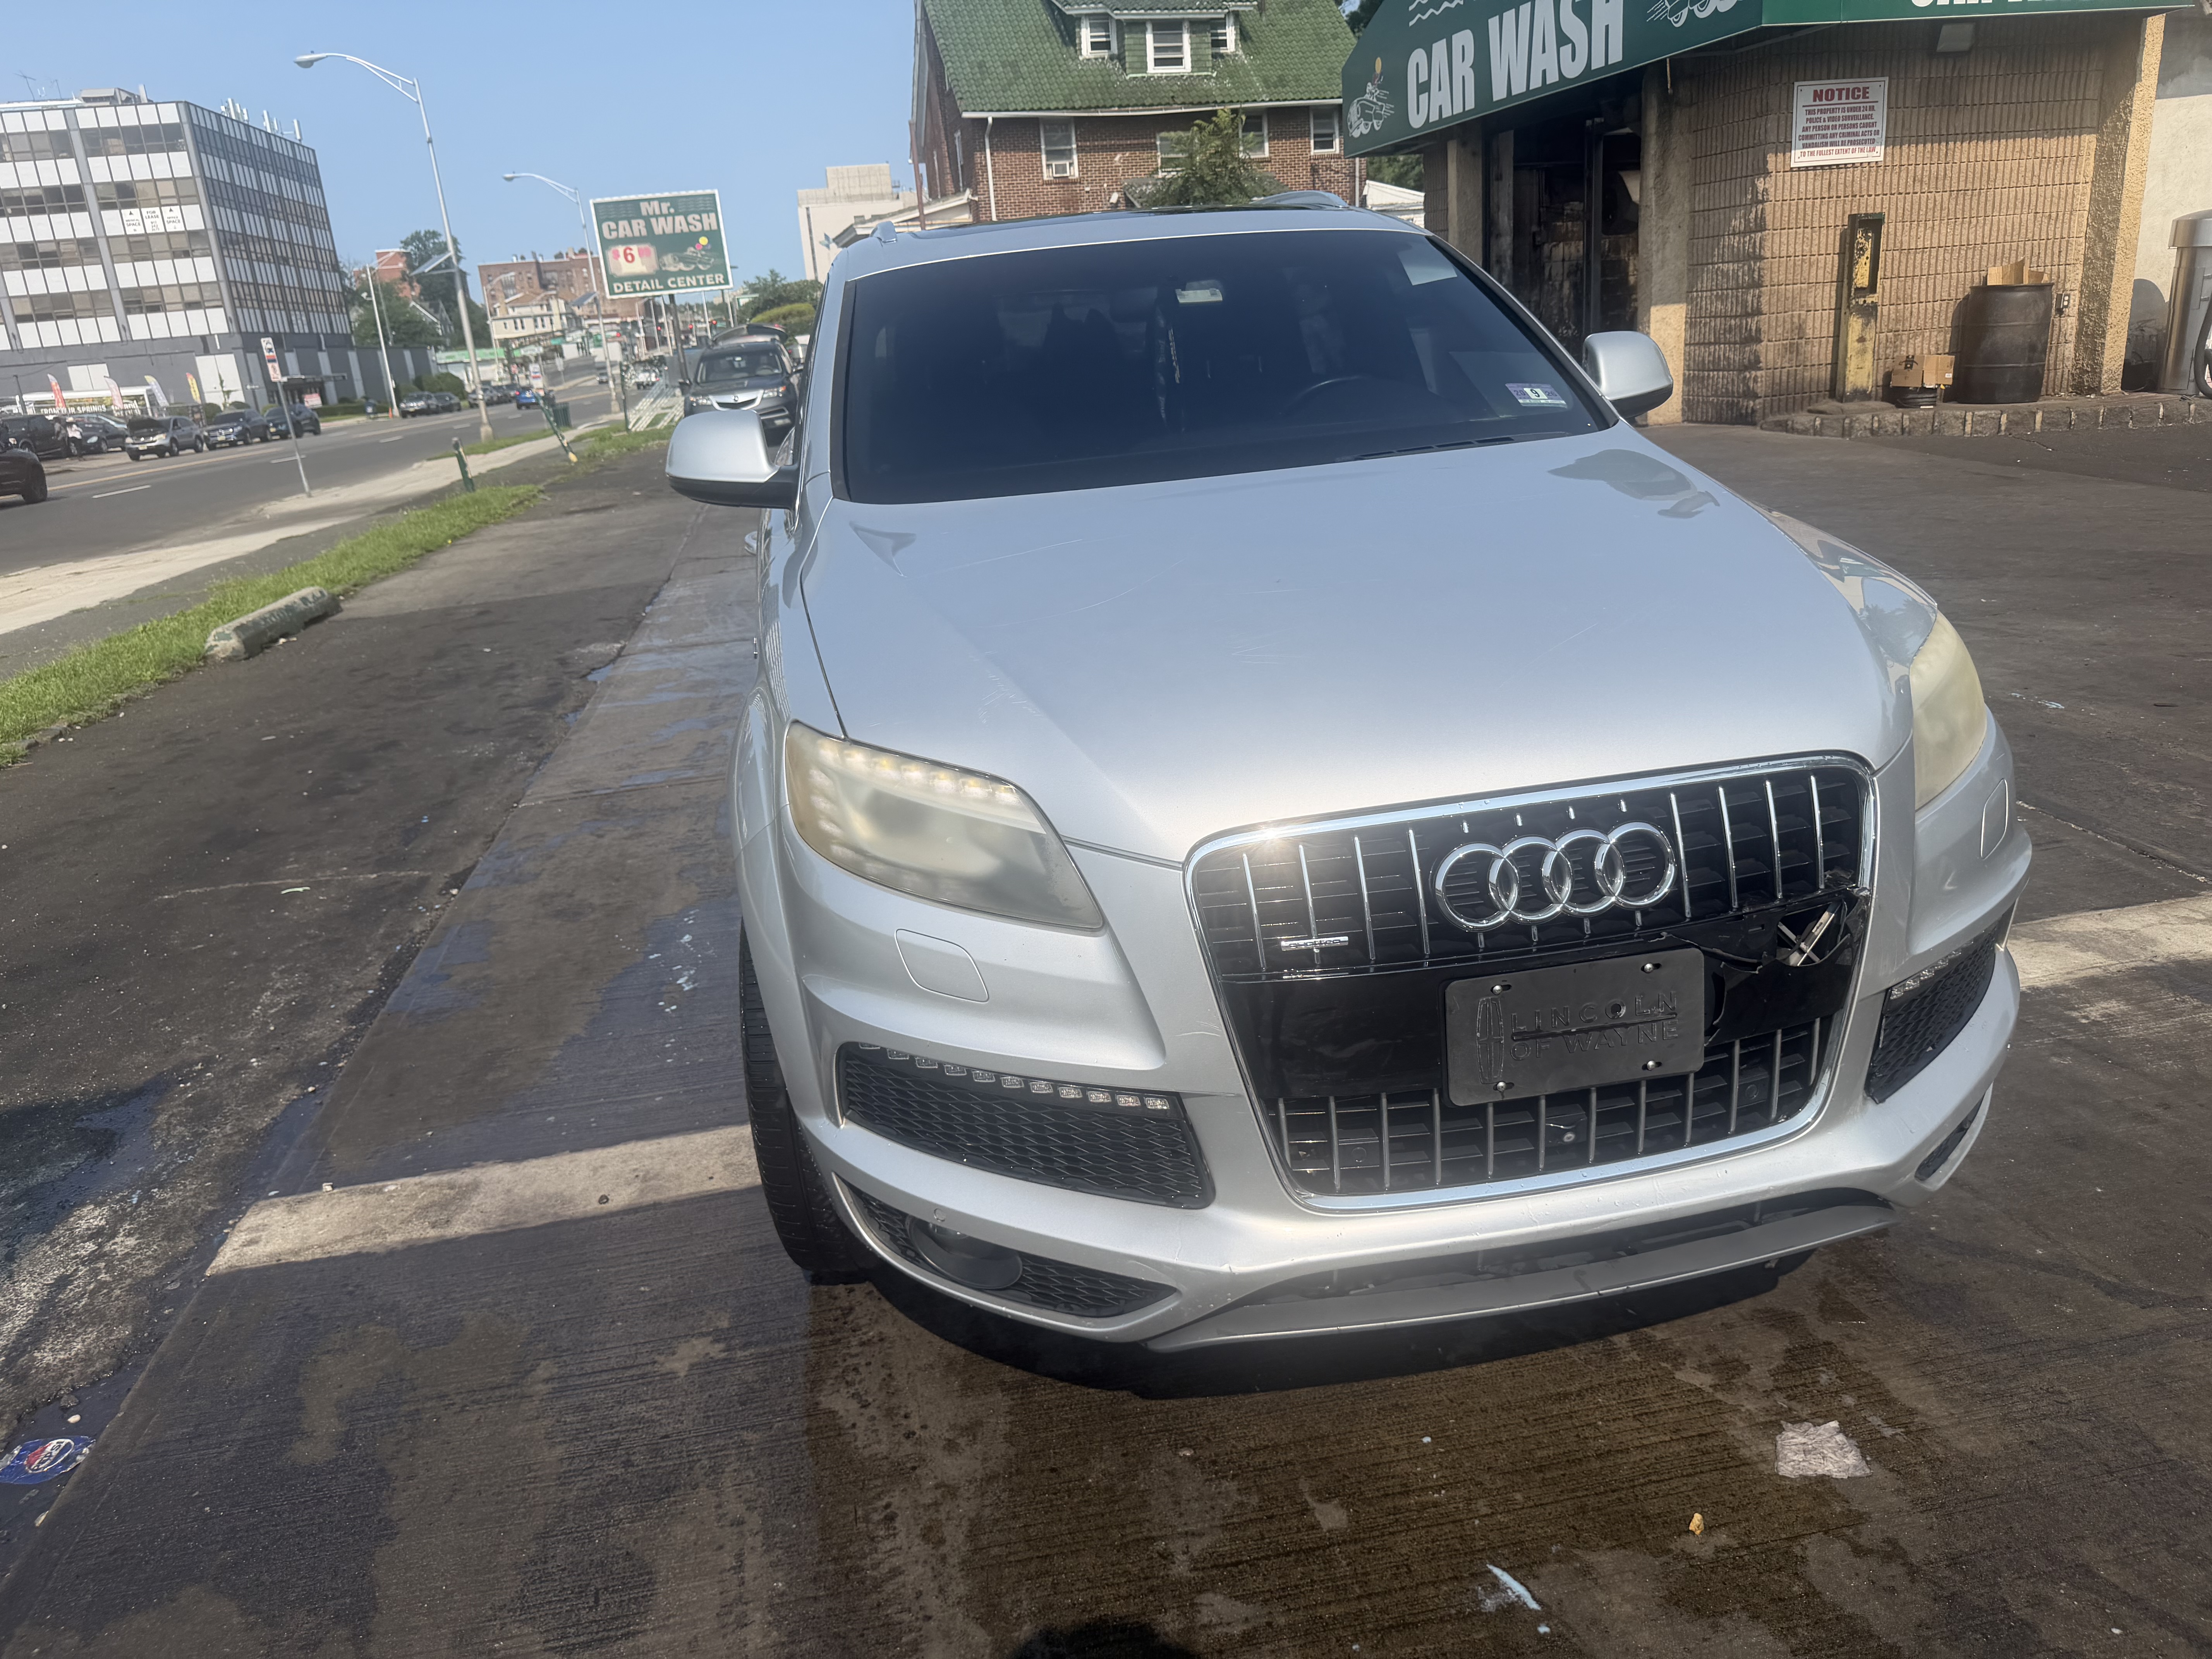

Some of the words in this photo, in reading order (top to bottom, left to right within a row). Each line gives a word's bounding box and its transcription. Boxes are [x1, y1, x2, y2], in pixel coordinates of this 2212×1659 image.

[1407, 29, 1475, 129] CAR
[1488, 0, 1623, 101] WASH
[1813, 87, 1870, 102] NOTICE
[1798, 133, 1828, 141] COMMITTING
[640, 201, 675, 216] Mr.
[601, 219, 647, 239] CAR
[649, 213, 718, 235] WASH
[613, 279, 664, 293] DETAIL
[667, 273, 725, 288] CENTER
[1530, 389, 1540, 397] 9
[1511, 991, 1676, 1032] LINCOLN
[1511, 1037, 1551, 1060] OF
[1563, 1019, 1678, 1053] WAYNE
